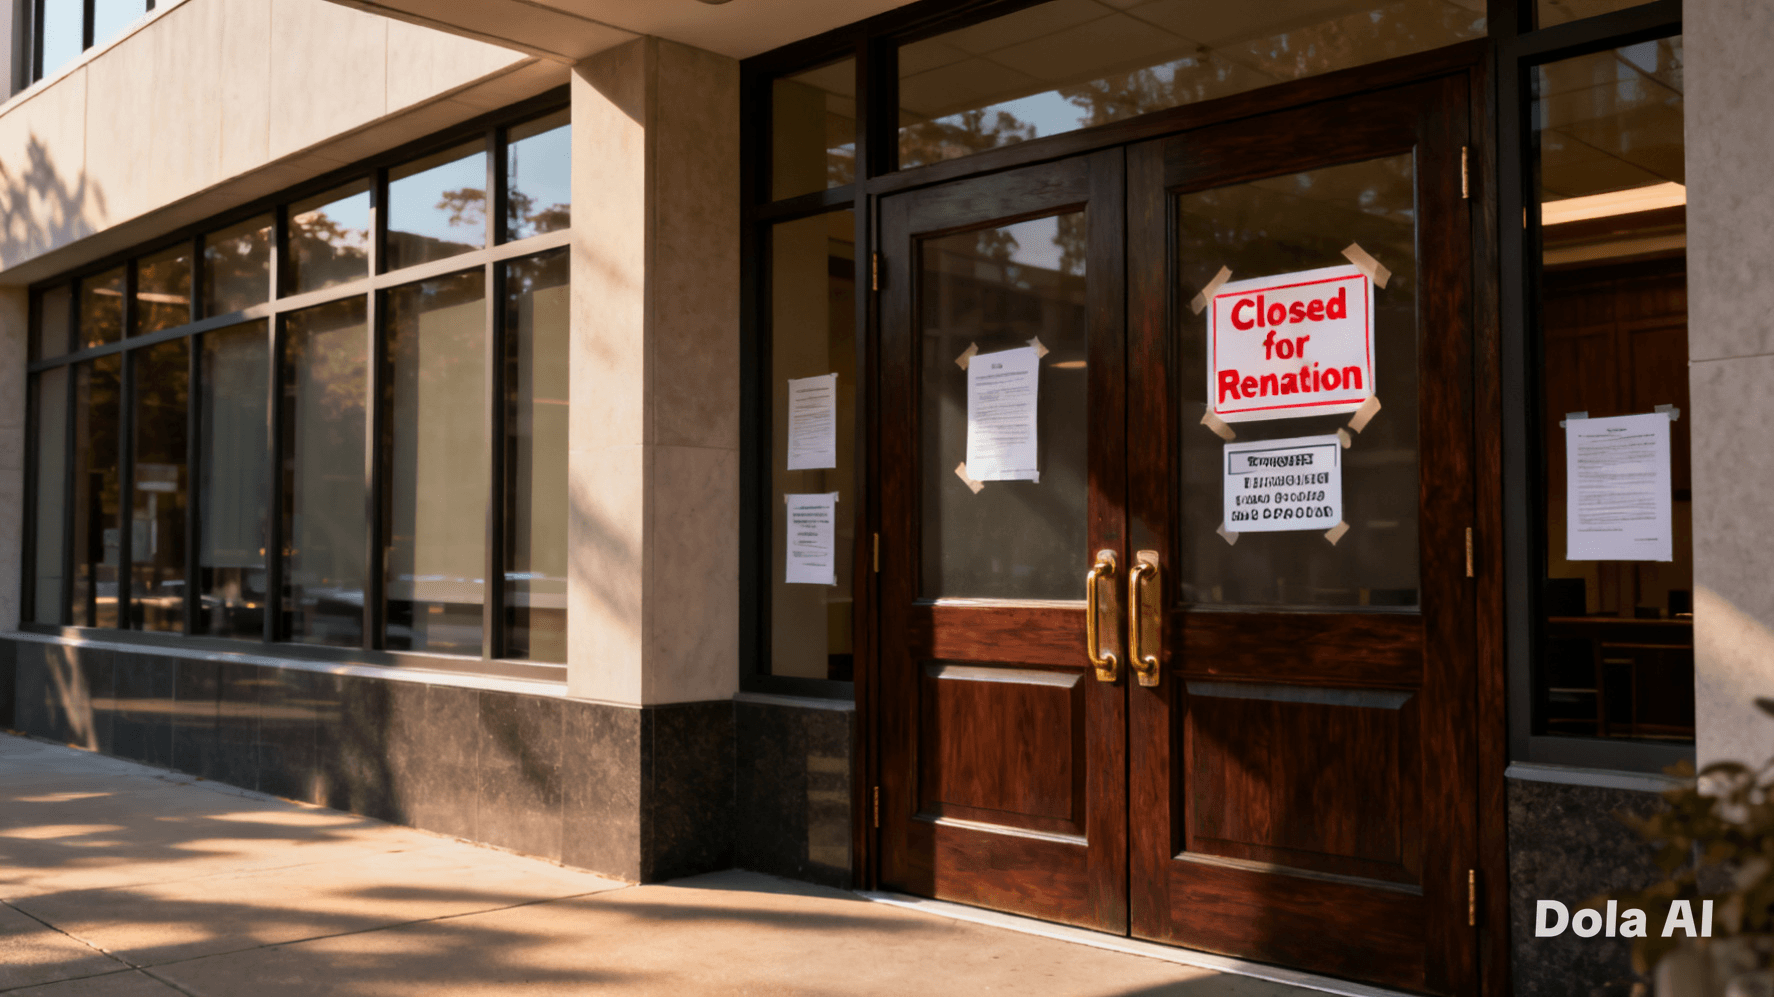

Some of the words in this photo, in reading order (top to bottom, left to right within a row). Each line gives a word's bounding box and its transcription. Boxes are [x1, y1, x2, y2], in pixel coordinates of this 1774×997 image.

[1231, 286, 1347, 331] Closed
[1262, 330, 1310, 361] for
[1218, 361, 1363, 405] Renation
